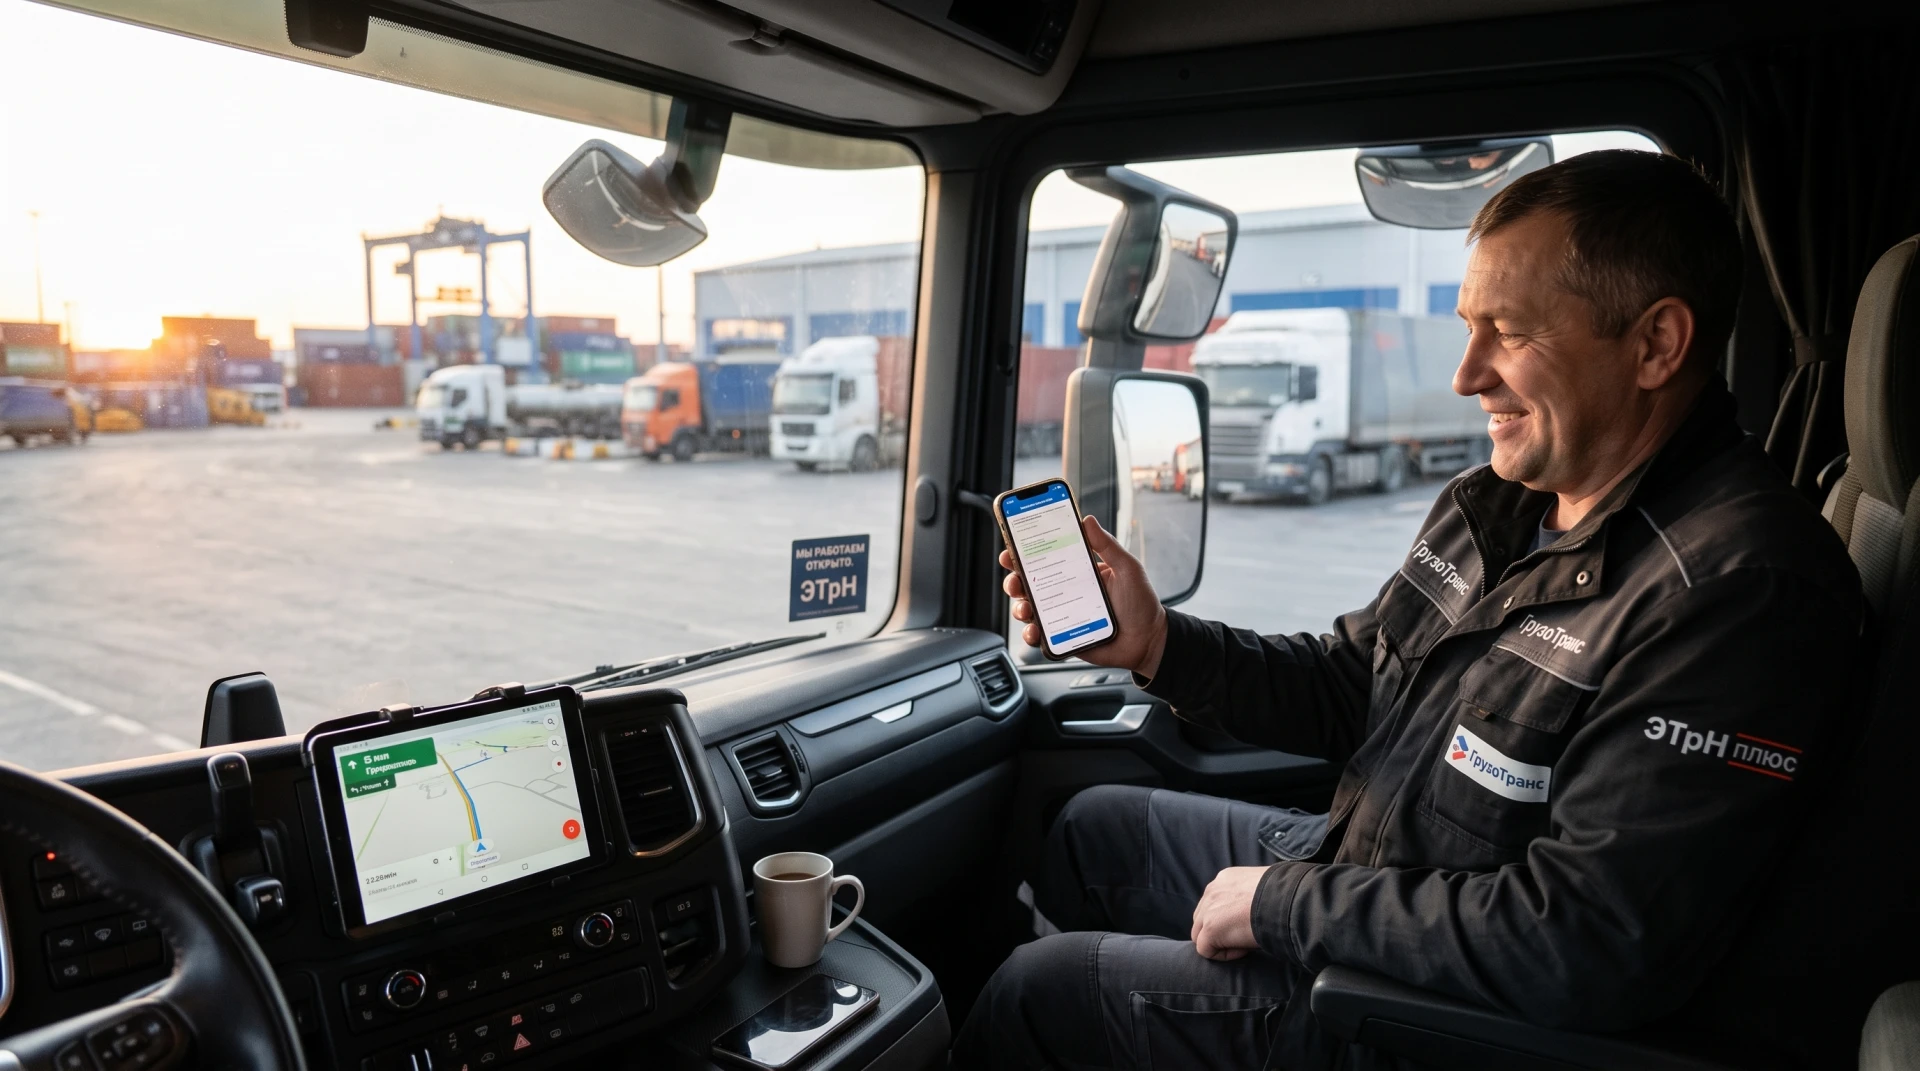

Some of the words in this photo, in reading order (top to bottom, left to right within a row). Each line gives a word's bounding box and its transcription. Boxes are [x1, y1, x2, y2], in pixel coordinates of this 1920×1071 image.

[795, 548, 813, 559] МЫ
[814, 543, 866, 557] РАБОТАЕМ
[805, 557, 854, 571] ОТКРЫТО.
[1412, 539, 1470, 596] ГрузоТранс
[800, 575, 858, 605] ЭТрН
[1519, 614, 1586, 654] ГрузоТранс
[1643, 716, 1730, 758] ЭТрН
